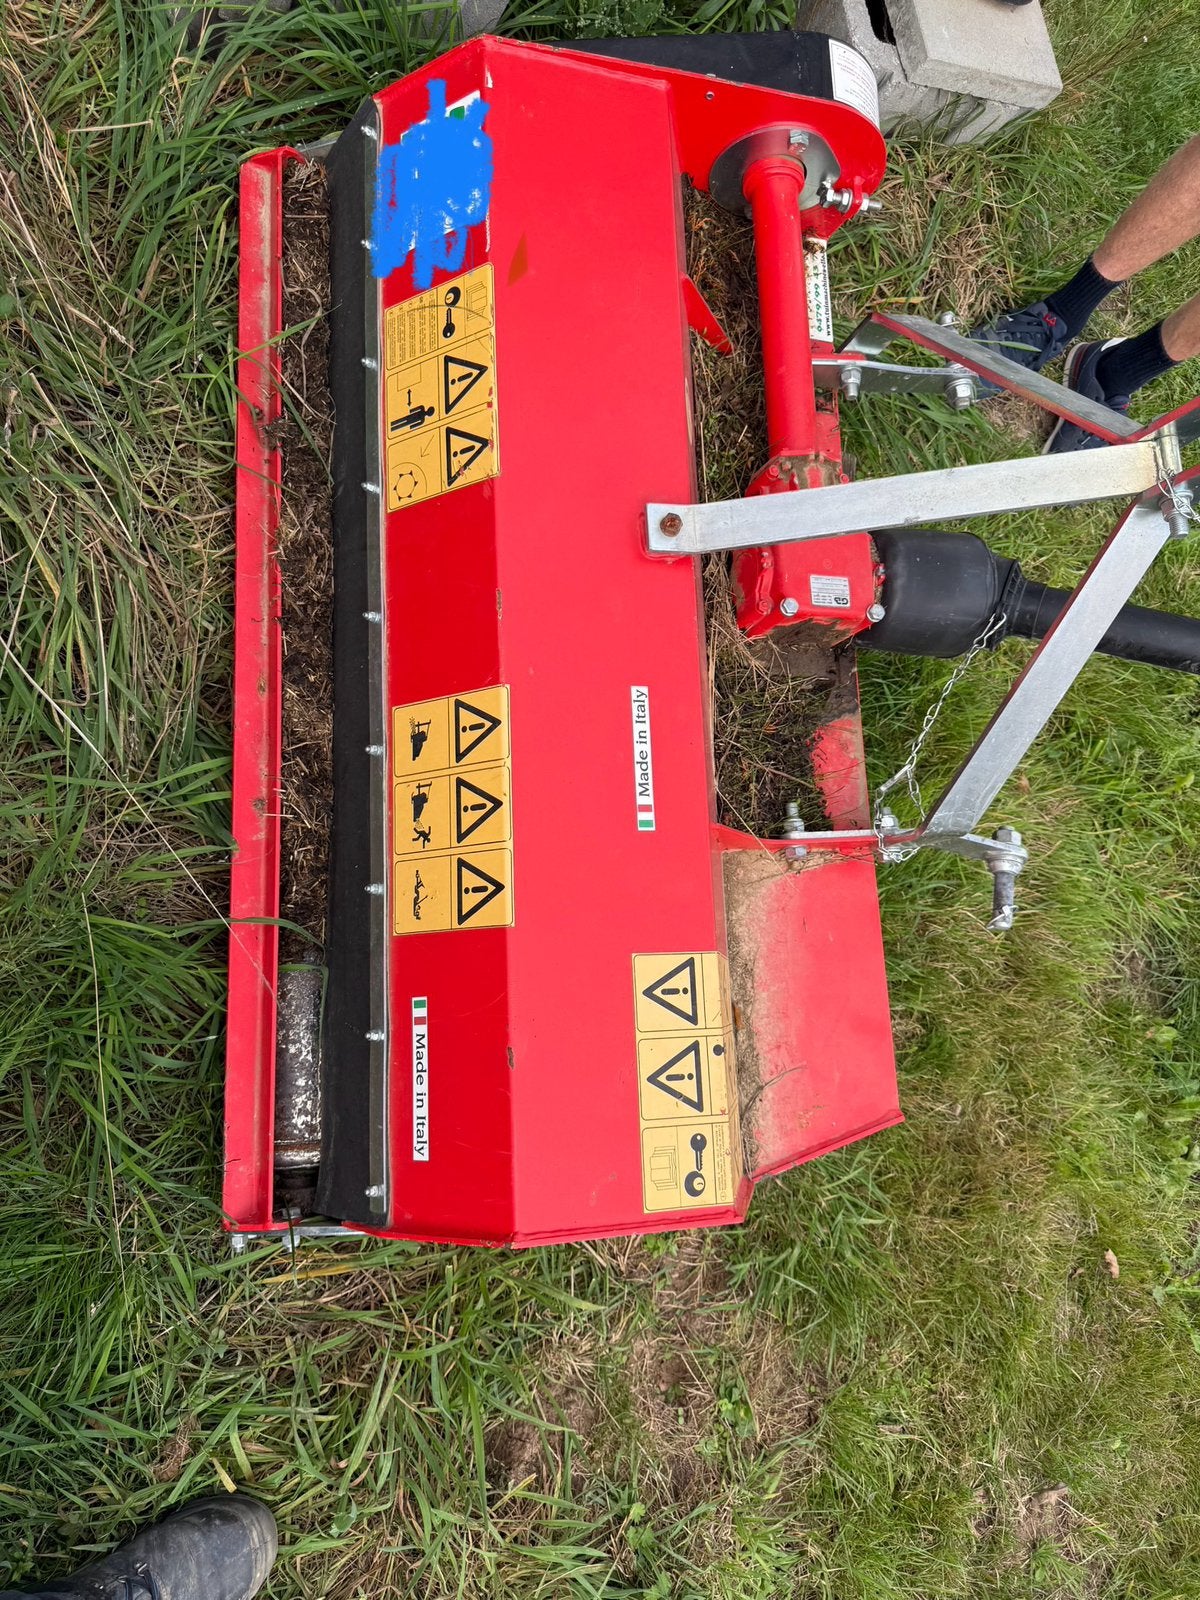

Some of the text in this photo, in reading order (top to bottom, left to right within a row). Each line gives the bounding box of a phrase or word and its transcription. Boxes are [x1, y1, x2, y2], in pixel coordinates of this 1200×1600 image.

[633, 689, 650, 797] Made in Italy
[414, 1033, 428, 1156] Made in Italy
